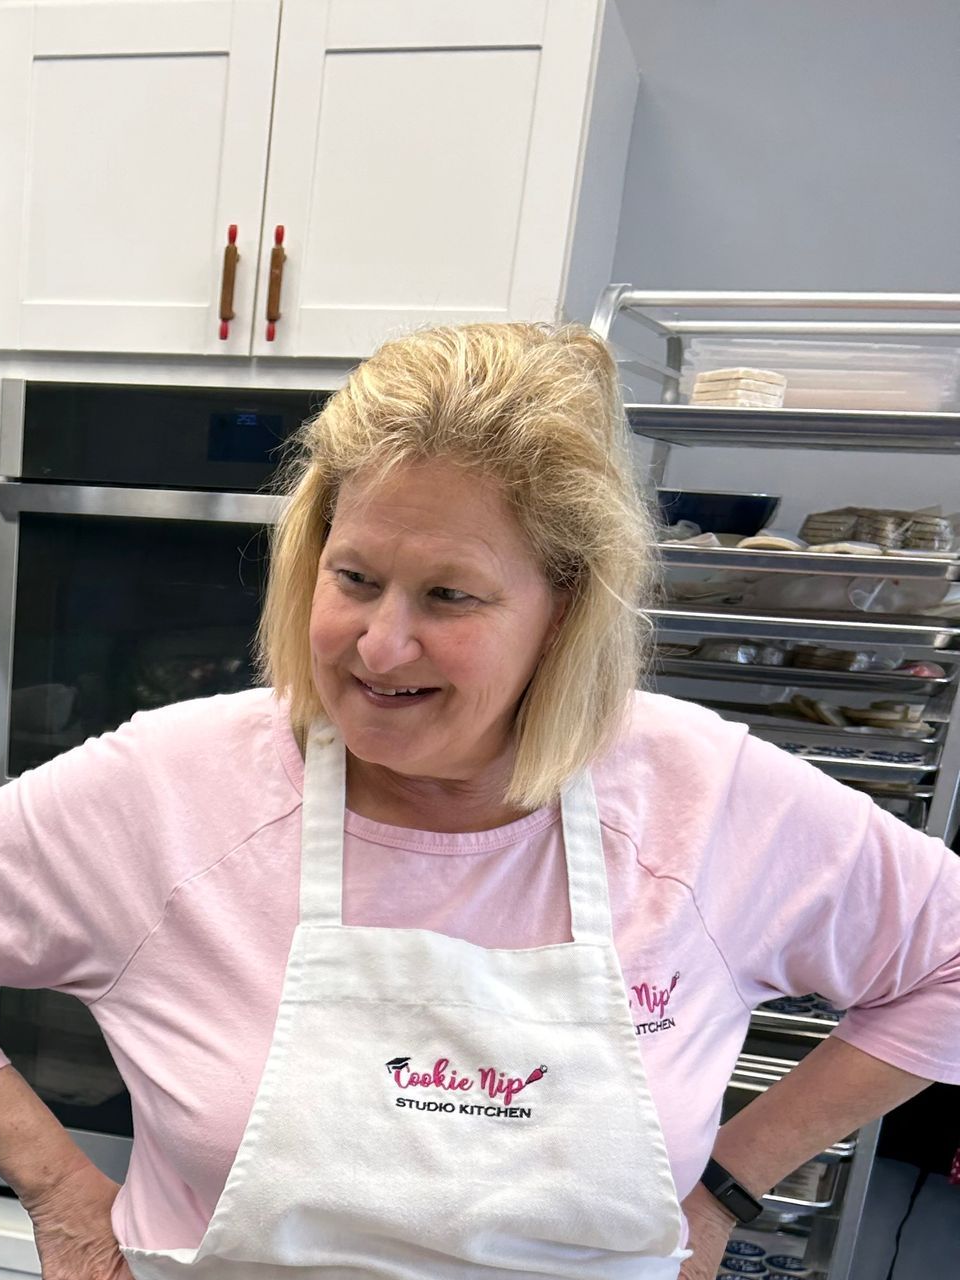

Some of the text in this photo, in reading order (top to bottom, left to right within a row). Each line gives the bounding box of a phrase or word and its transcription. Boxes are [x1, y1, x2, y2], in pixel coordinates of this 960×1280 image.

[635, 1017, 676, 1036] ITCHEN
[394, 1058, 527, 1106] Cookie Nip
[395, 1097, 532, 1119] STUDIO KITCHEN
